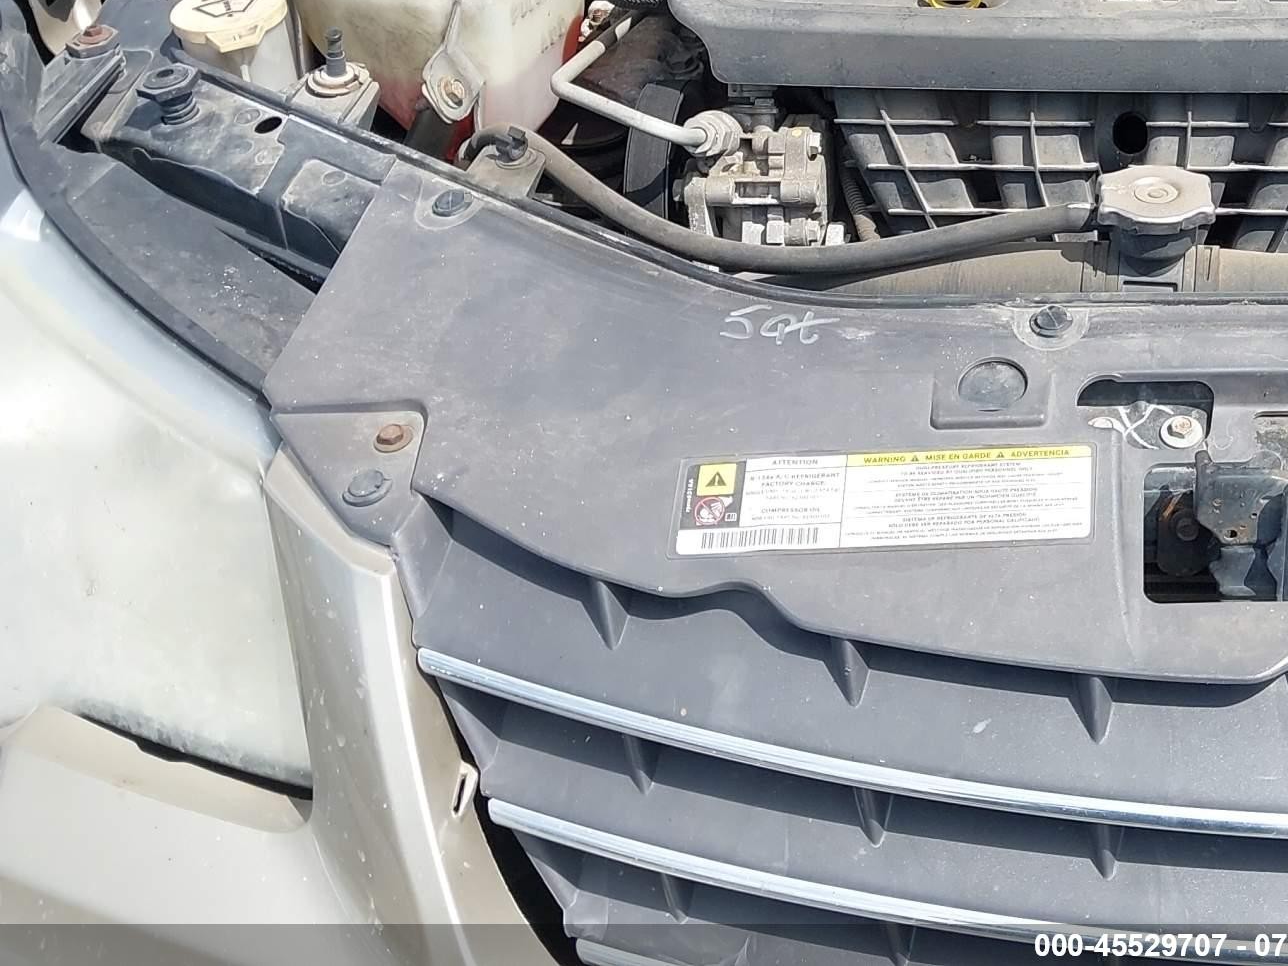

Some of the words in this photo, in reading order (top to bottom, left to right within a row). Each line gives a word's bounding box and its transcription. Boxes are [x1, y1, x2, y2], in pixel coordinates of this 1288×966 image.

[863, 456, 906, 464] WARNING
[962, 451, 991, 459] GARDE
[1010, 449, 1070, 458] ADVERTENCIA
